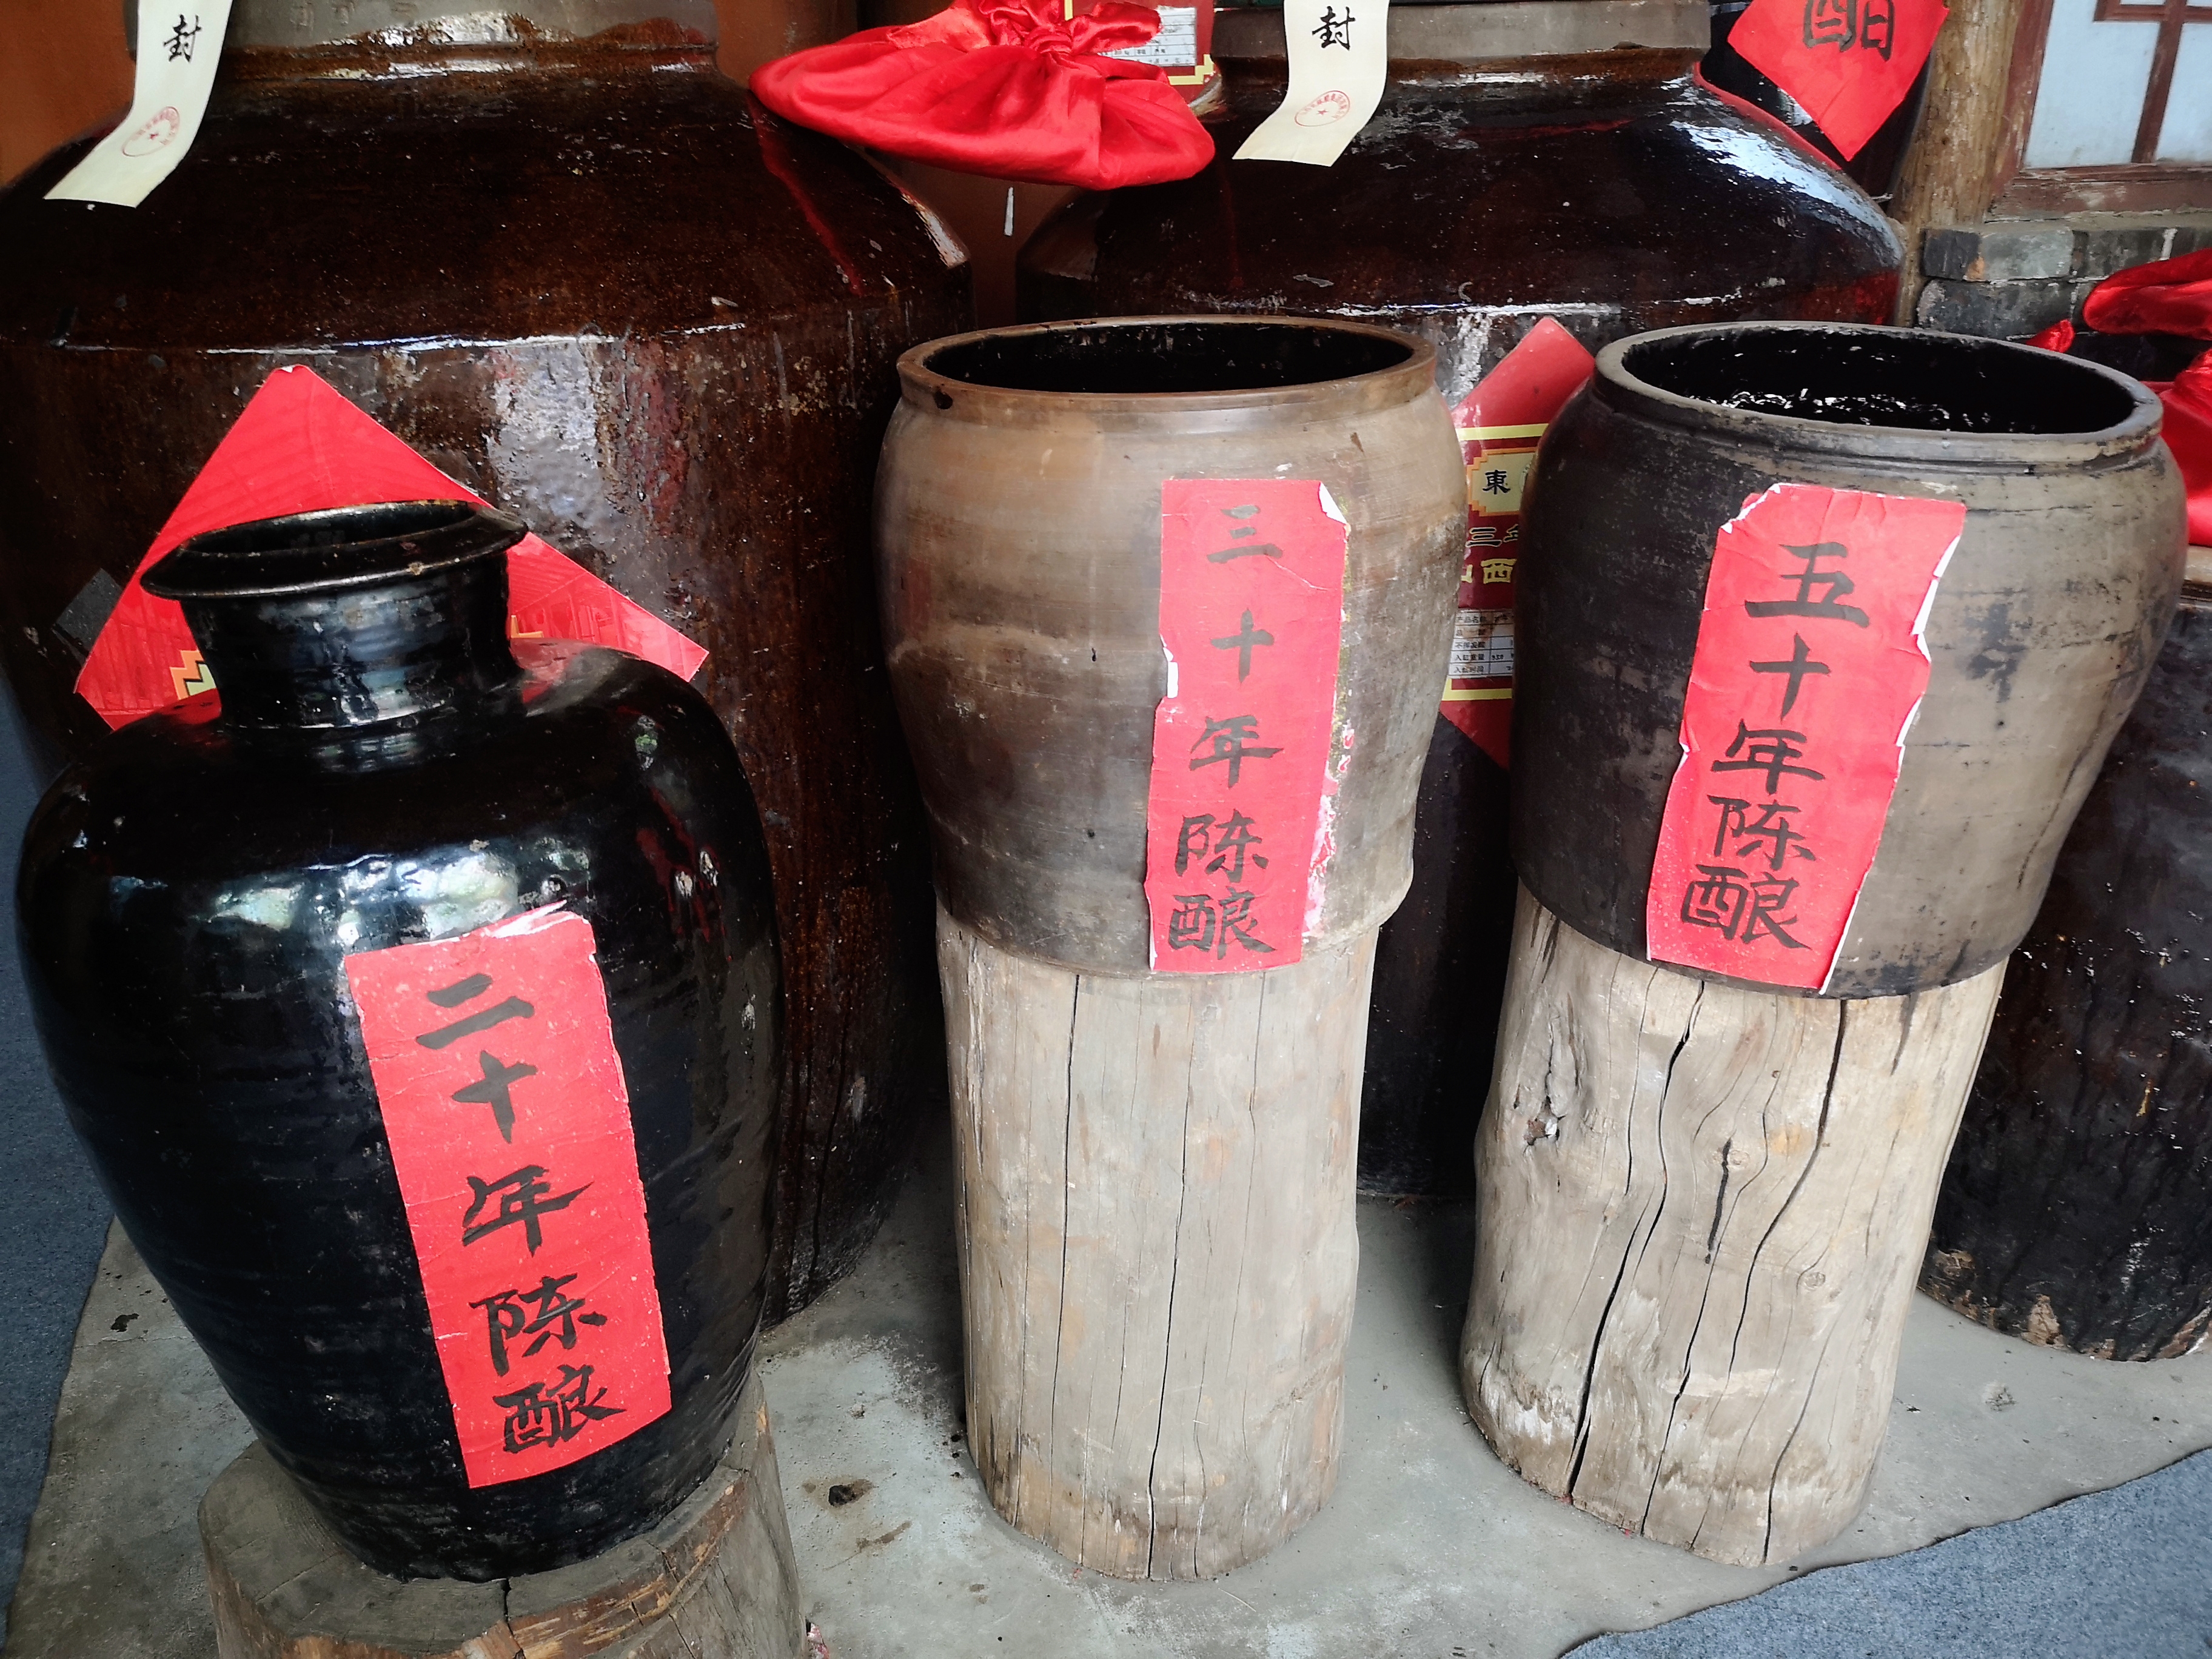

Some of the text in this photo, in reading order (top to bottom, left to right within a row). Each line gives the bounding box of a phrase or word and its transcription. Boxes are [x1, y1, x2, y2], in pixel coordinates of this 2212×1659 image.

[163, 15, 201, 63] 封
[1312, 5, 1355, 51] 封
[1483, 469, 1510, 495] 東
[1168, 504, 1285, 960] 三十年陈酿
[1680, 541, 1869, 951] 五十年陈酿
[415, 973, 626, 1455] 二十年陈酿
